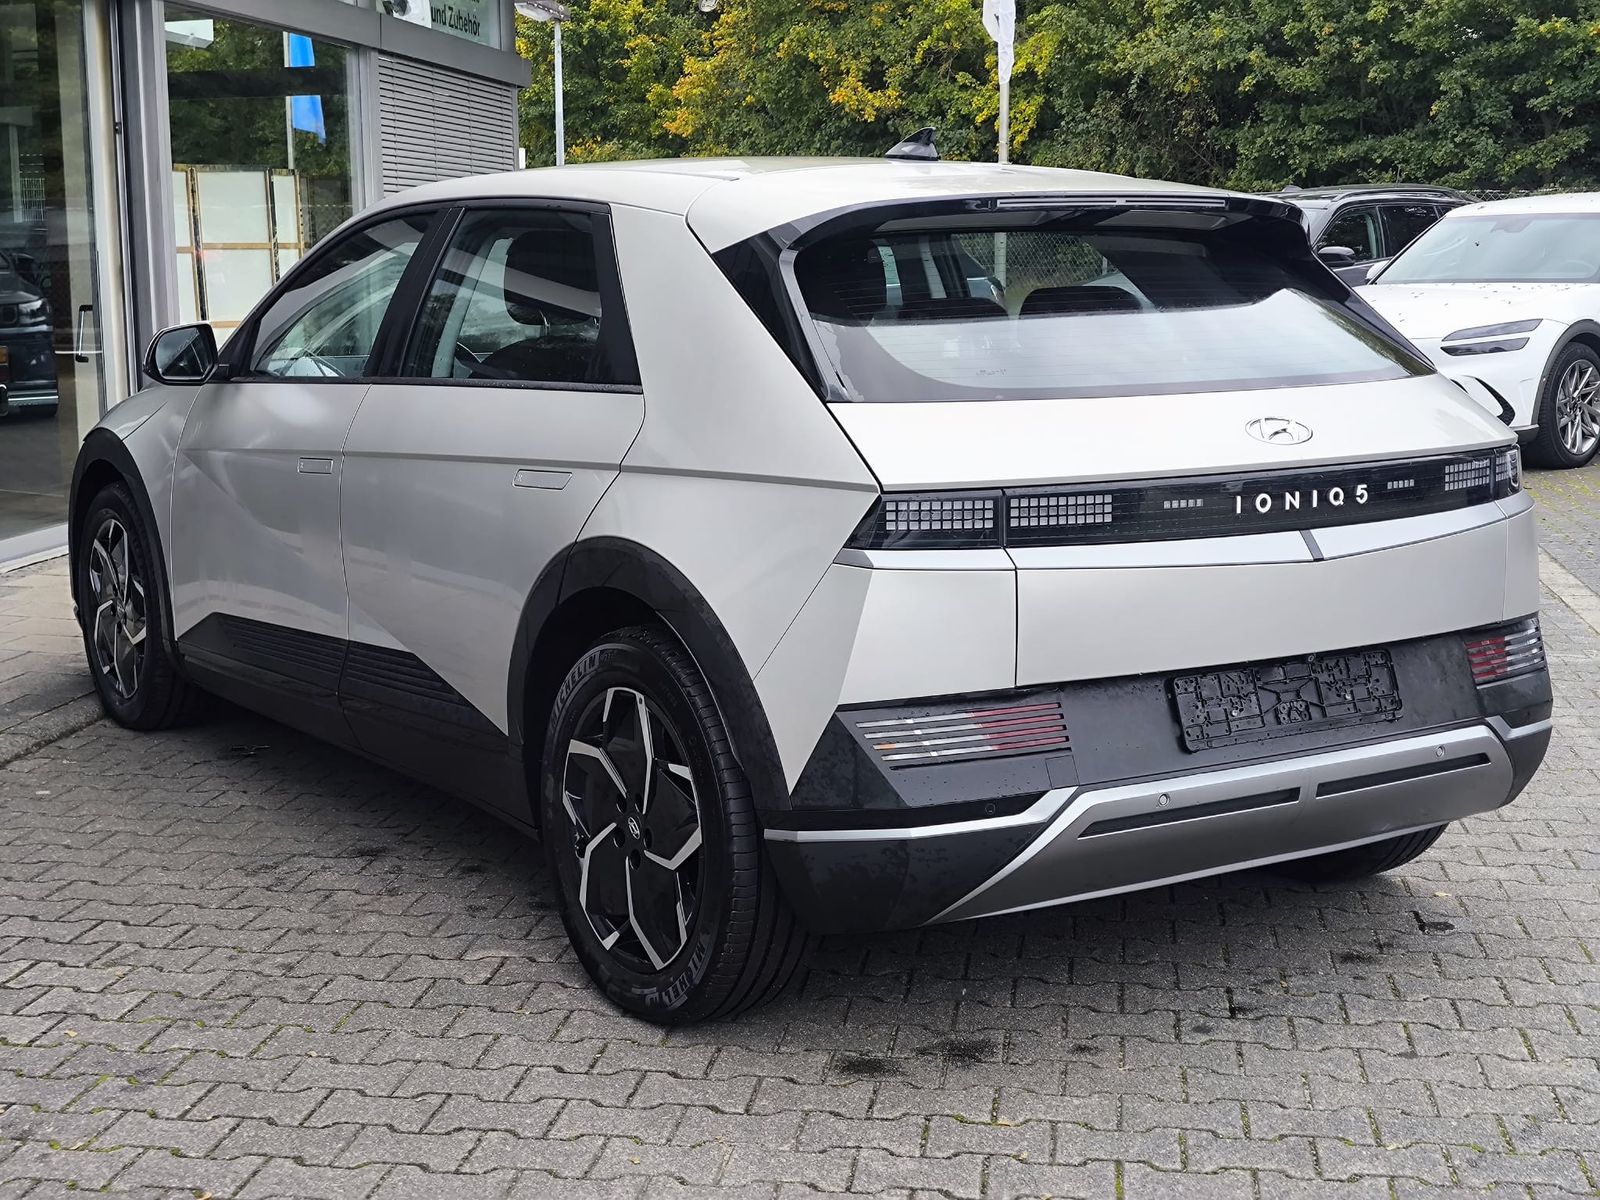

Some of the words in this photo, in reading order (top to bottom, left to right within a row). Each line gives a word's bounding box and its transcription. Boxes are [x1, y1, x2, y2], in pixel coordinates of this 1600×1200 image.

[431, 5, 447, 26] und
[448, 6, 481, 37] Zubehör
[549, 651, 600, 731] MICHELIN
